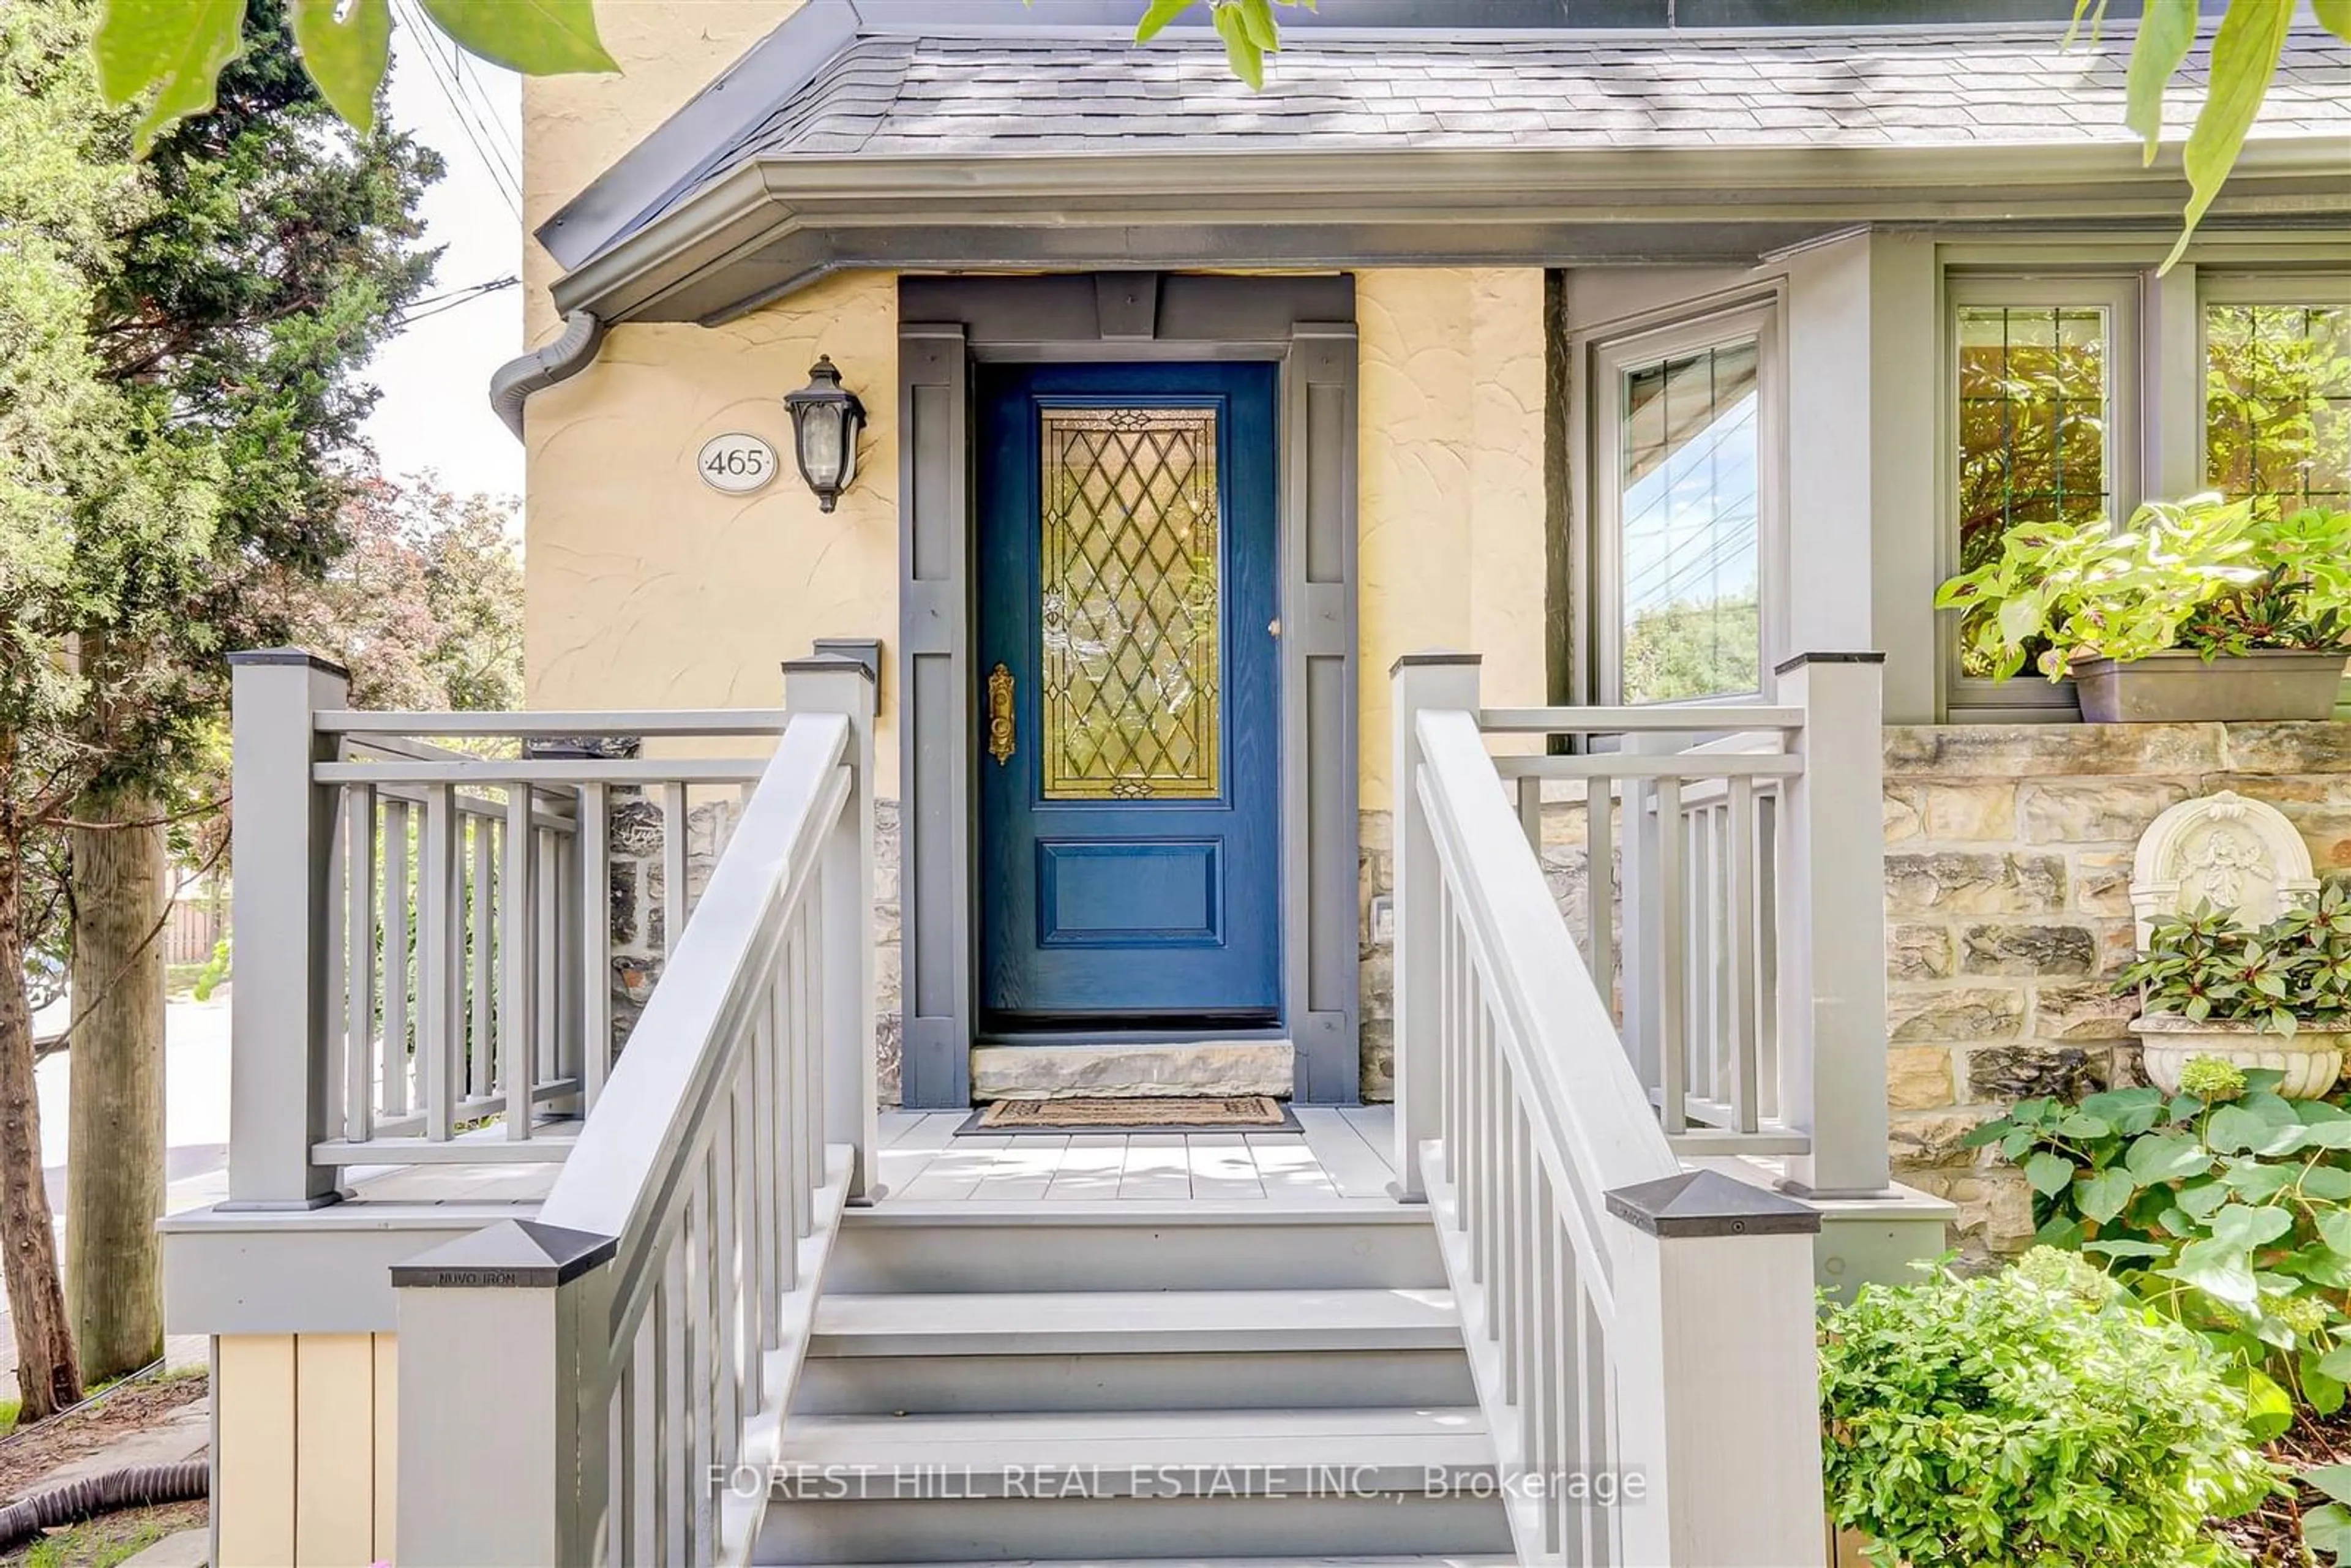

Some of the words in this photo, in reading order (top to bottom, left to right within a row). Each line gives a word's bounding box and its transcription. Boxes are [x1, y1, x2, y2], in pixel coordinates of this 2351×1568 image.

[706, 449, 763, 475] 465
[439, 1273, 476, 1283] NUVO
[482, 1273, 515, 1283] IRON
